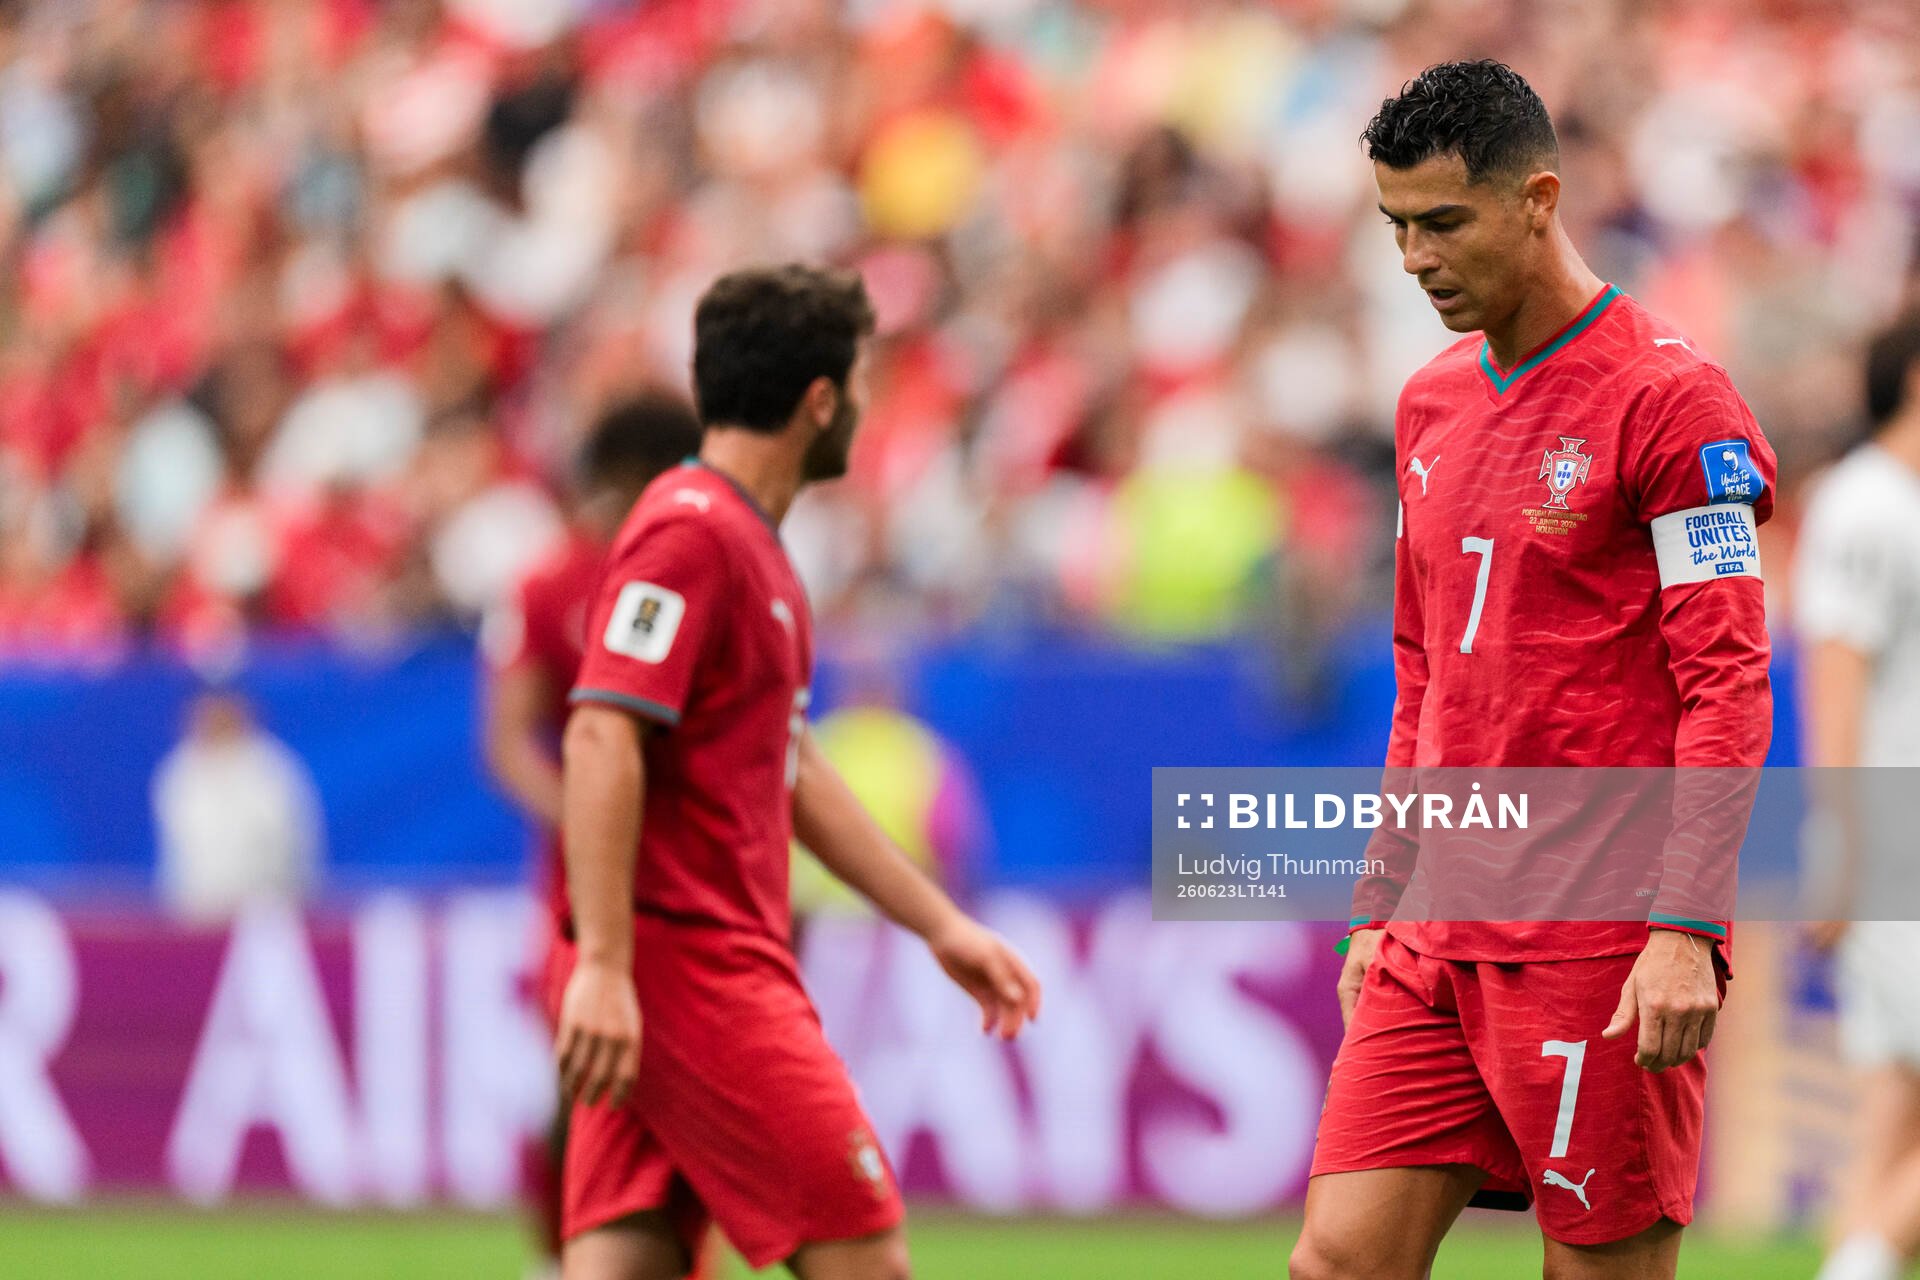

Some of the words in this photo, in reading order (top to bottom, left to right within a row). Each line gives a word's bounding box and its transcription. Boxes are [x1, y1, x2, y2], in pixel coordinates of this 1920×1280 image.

[1725, 482, 1751, 496] PEACE
[1535, 525, 1568, 536] HOUSTON
[1685, 511, 1746, 530] FOOTBALL
[1688, 525, 1751, 548] UNITES
[1689, 548, 1718, 565] the
[1718, 543, 1757, 561] World
[1718, 563, 1743, 574] FIFA
[1460, 536, 1494, 654] 7
[1541, 1040, 1588, 1158] 7
